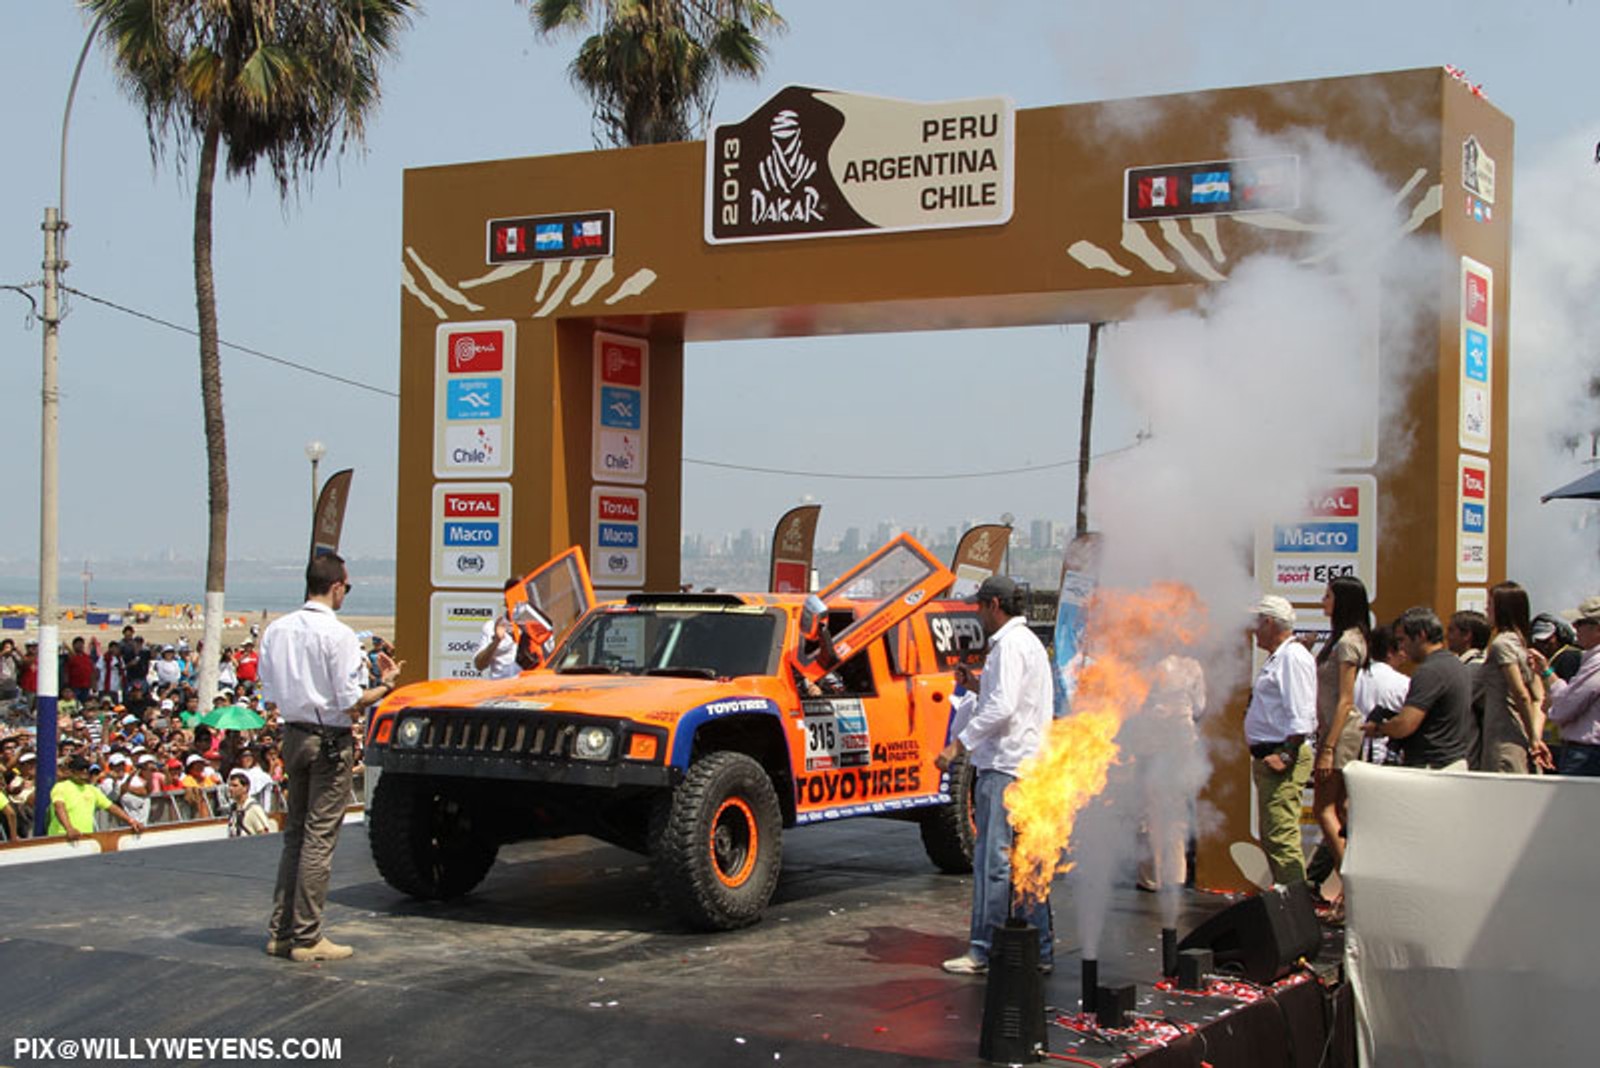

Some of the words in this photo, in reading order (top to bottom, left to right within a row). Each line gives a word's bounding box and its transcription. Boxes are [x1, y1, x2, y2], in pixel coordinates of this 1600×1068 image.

[922, 113, 998, 143] PERU
[843, 148, 997, 184] ARGENTINA
[722, 137, 740, 226] 2013
[921, 183, 997, 211] CHILE
[750, 186, 824, 224] DAKAR
[453, 448, 486, 464] Chile
[605, 454, 629, 469] Chile
[448, 497, 496, 512] TOTAL
[602, 501, 636, 515] TOTAL
[1312, 496, 1353, 510] TAL
[450, 527, 493, 542] Macro
[603, 528, 634, 543] Macro
[1283, 529, 1348, 546] Macro
[462, 557, 480, 568] FOX
[1277, 574, 1310, 584] sport
[809, 722, 835, 751] 315
[873, 743, 887, 763] 4
[887, 740, 919, 750] WHEEL
[889, 751, 919, 761] PARTS
